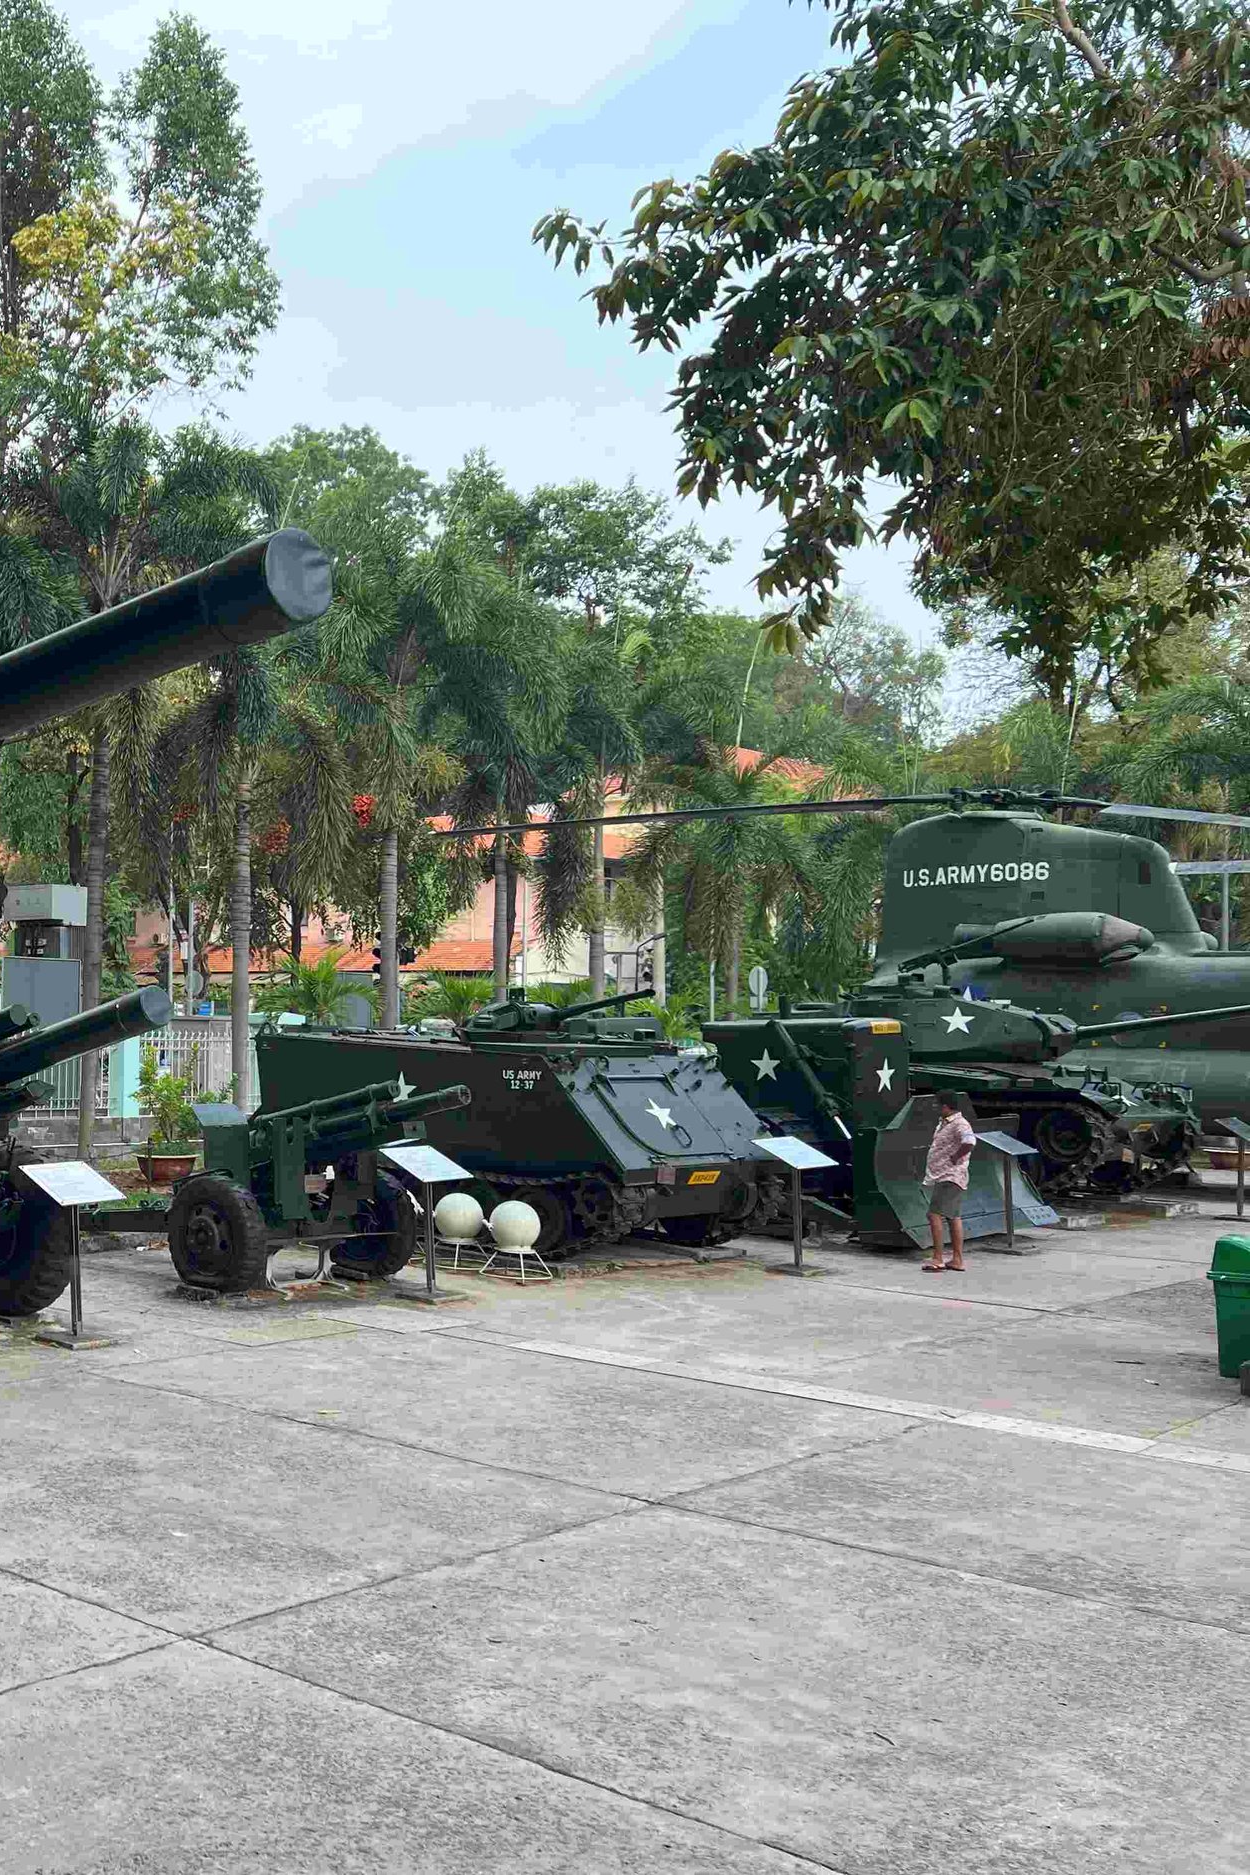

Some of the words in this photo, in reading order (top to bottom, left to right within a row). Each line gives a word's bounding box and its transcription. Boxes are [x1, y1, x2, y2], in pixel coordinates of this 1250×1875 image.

[502, 1069, 515, 1080] US
[516, 1069, 542, 1080] ARMY
[510, 1080, 534, 1090] 12-37
